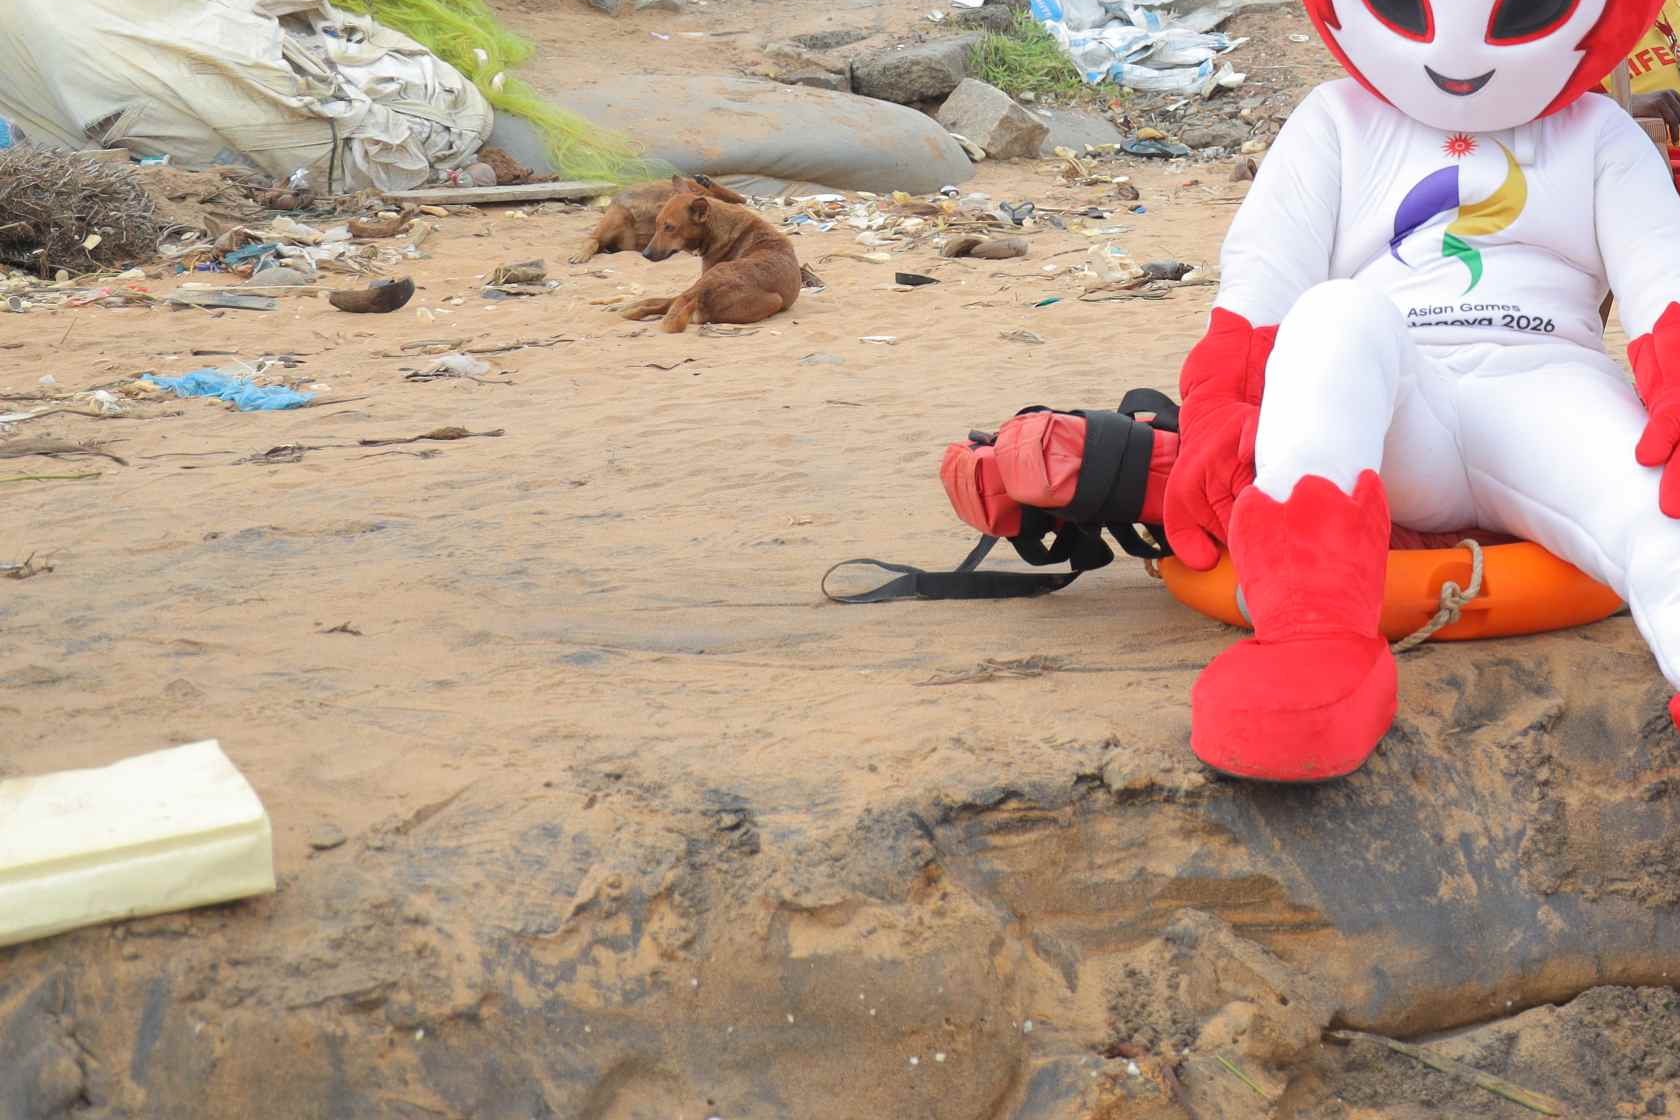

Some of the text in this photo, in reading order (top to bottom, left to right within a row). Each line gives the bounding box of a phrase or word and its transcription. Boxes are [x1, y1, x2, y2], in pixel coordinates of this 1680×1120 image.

[1407, 303, 1521, 318] Asian Games
[1501, 314, 1556, 333] 2026
